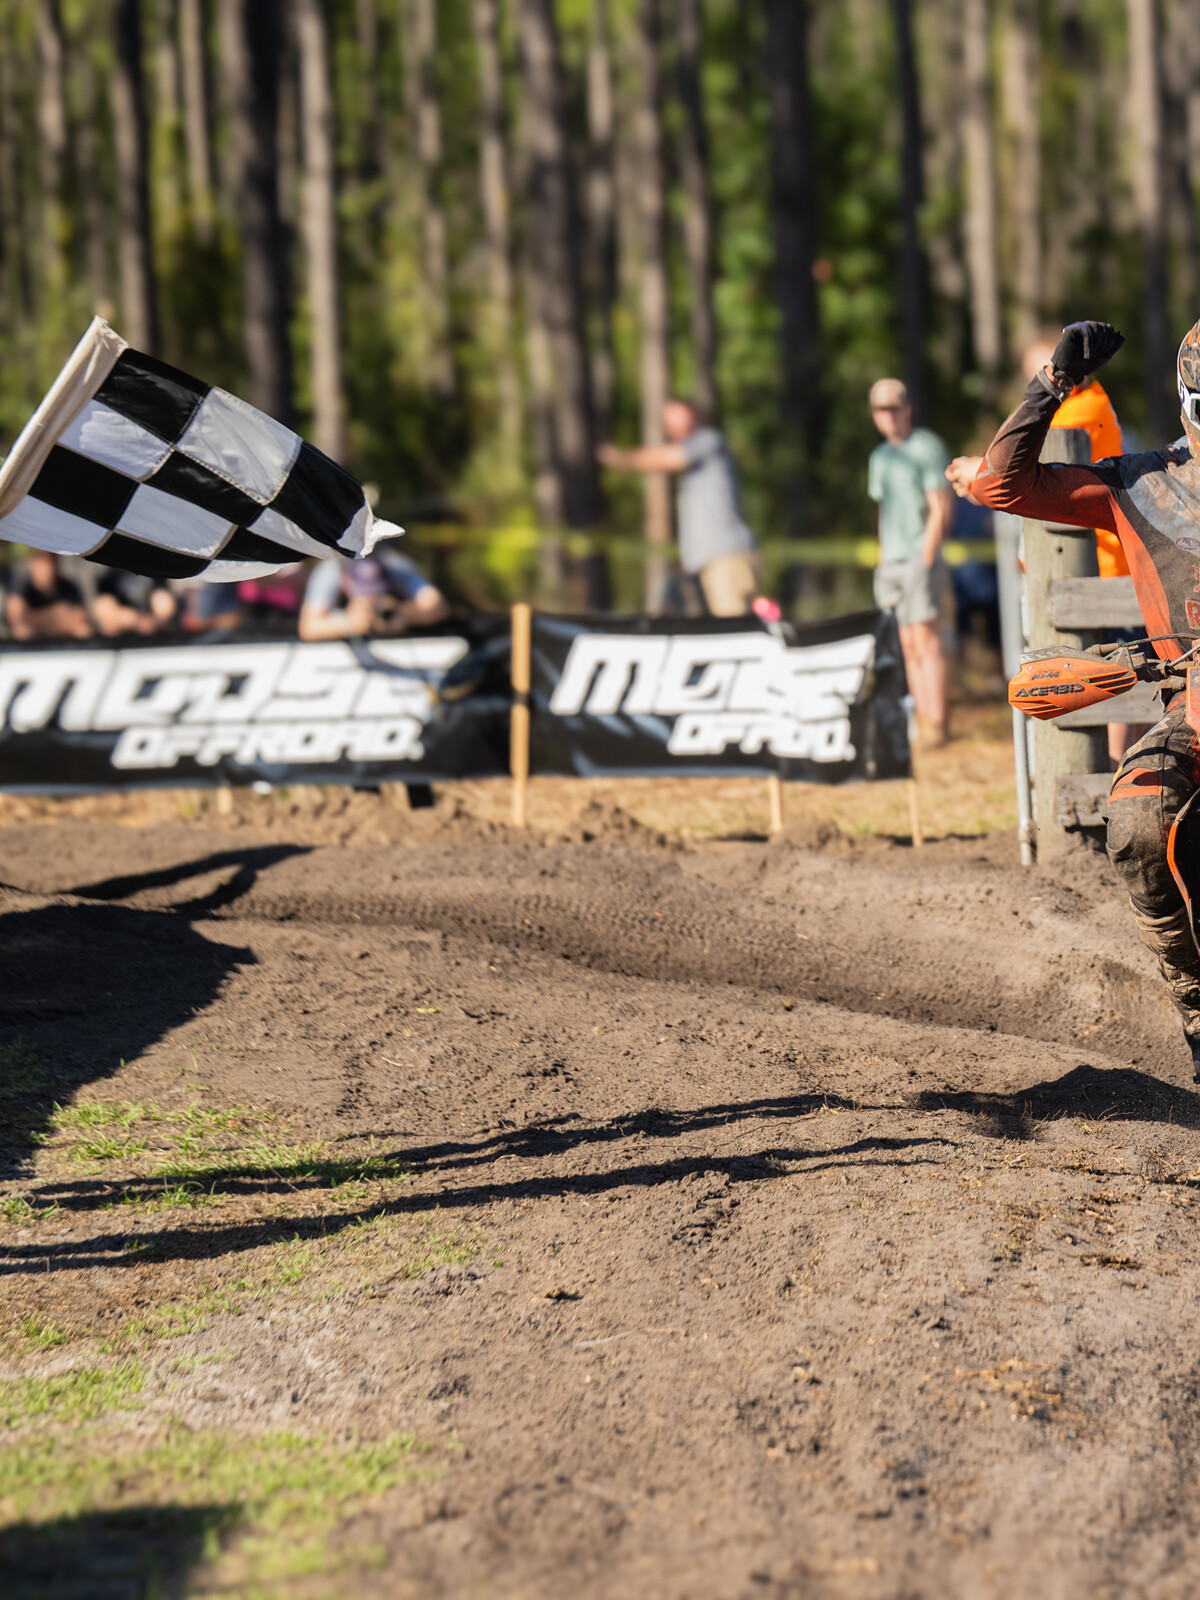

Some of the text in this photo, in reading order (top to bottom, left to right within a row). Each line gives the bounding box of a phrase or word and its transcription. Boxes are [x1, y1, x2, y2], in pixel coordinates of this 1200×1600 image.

[0, 637, 468, 732] MOOSE
[1014, 682, 1086, 698] ACERBIS
[1031, 669, 1060, 680] KTM
[111, 718, 420, 769] OFFROAD
